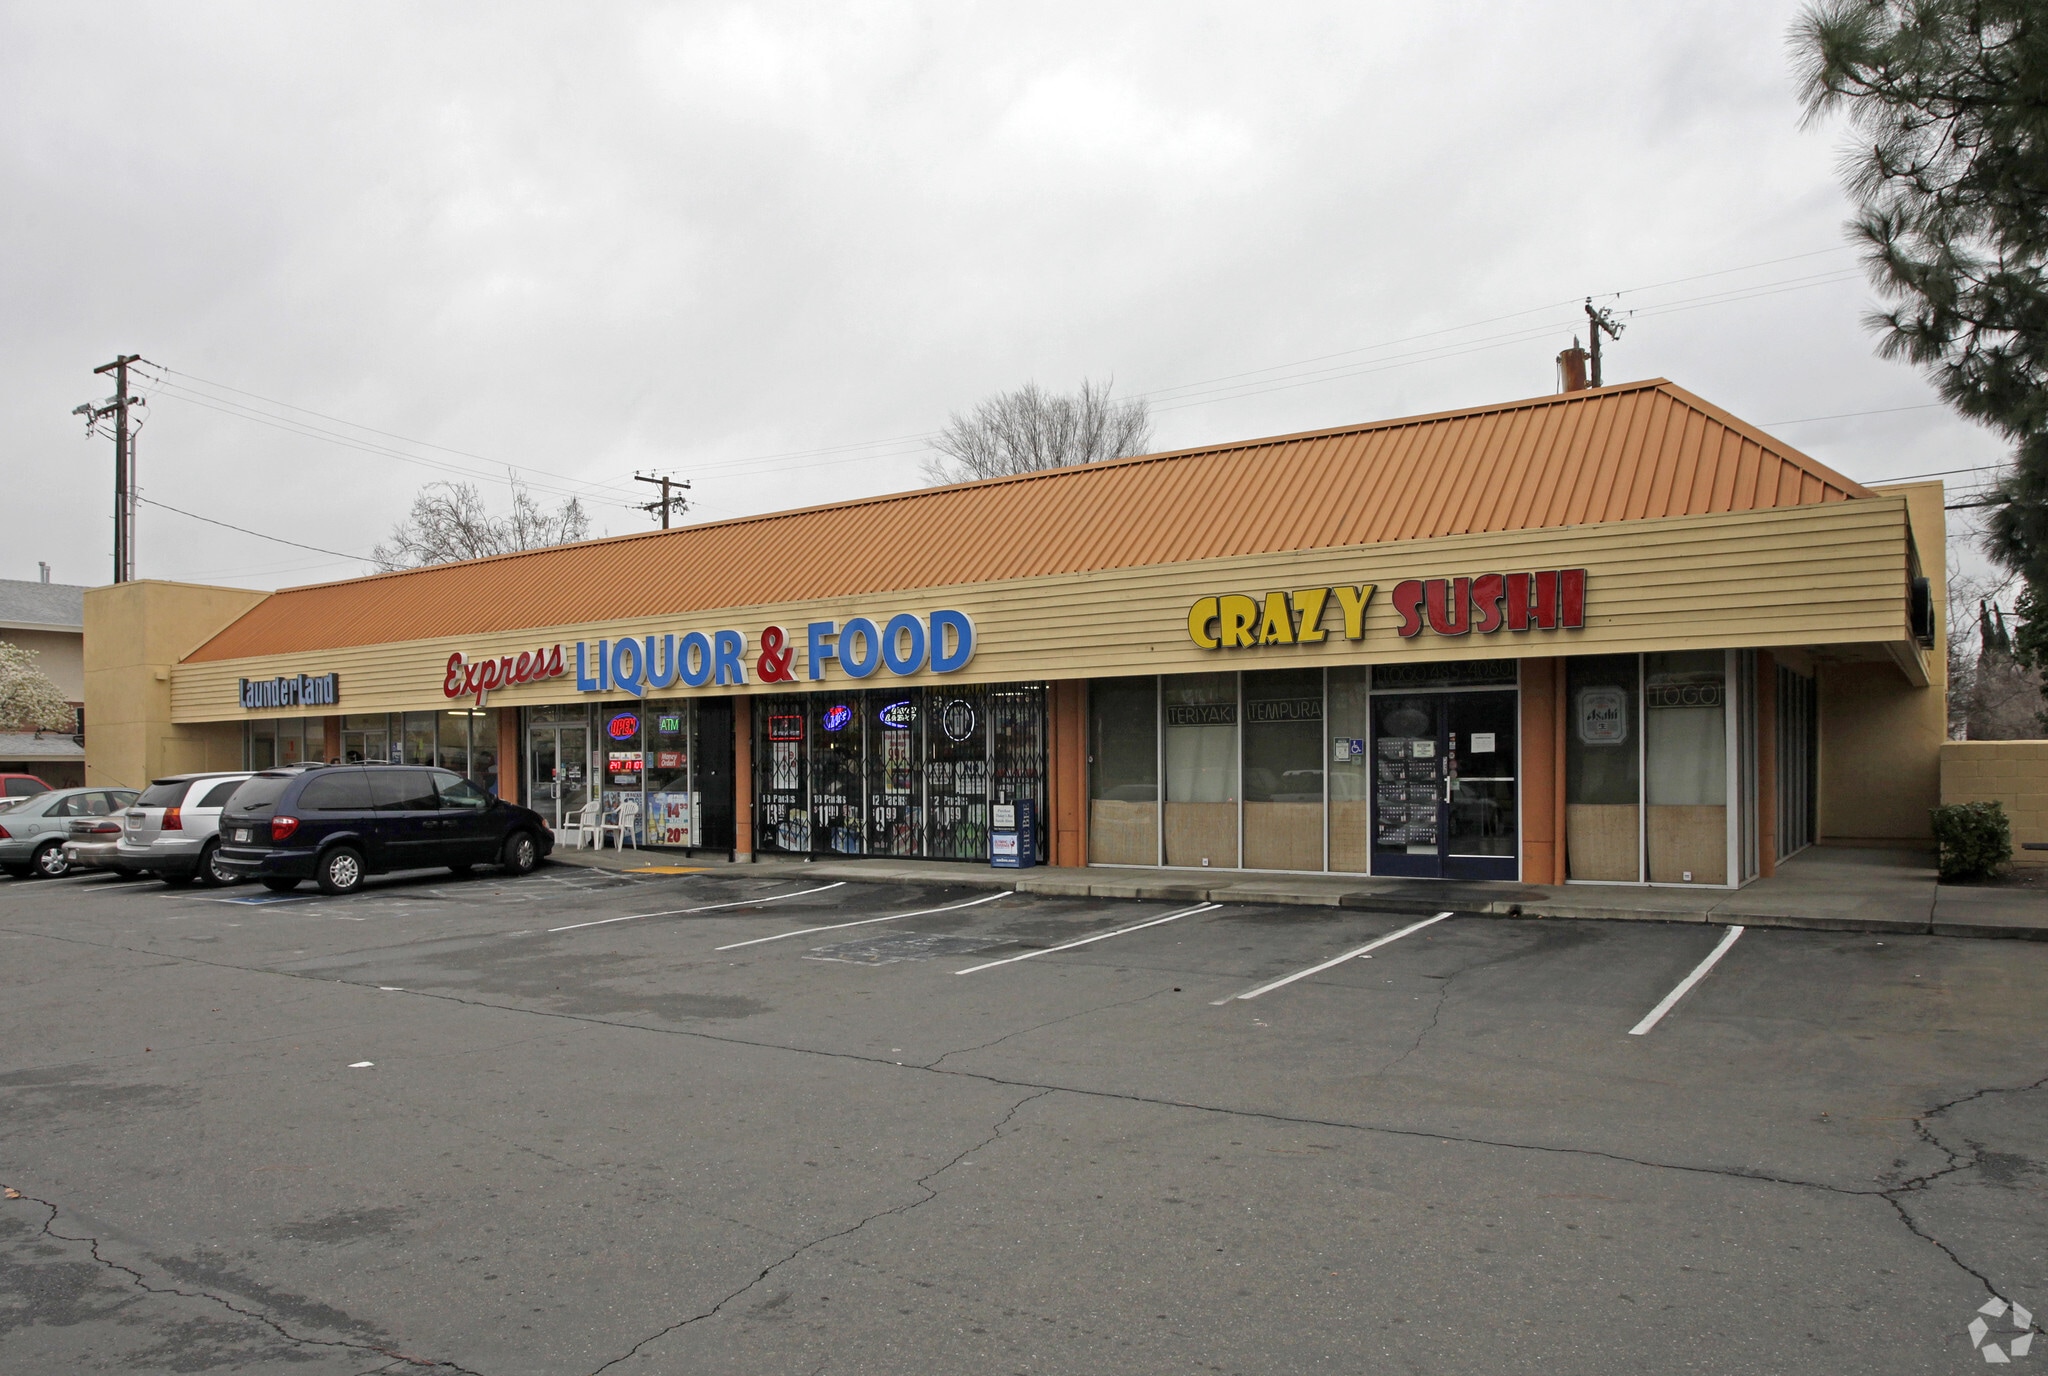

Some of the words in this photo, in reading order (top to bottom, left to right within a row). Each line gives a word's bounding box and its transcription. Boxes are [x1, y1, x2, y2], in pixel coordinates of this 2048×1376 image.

[1187, 583, 1377, 650] CRAZY
[1391, 568, 1587, 638] SUSHI
[443, 643, 569, 706] Express
[576, 629, 749, 698] LIQUOR
[756, 625, 799, 684] &
[807, 609, 978, 679] FOOD
[1652, 684, 1717, 705] TOGO
[1169, 705, 1235, 724] TERIYAKI
[1250, 700, 1322, 721] TEMPURA
[1586, 708, 1618, 721] Asahi
[610, 717, 637, 736] OPEN
[660, 719, 679, 731] ATM
[661, 753, 678, 761] Money
[1022, 803, 1030, 828] BEE
[1023, 829, 1031, 858] THE
